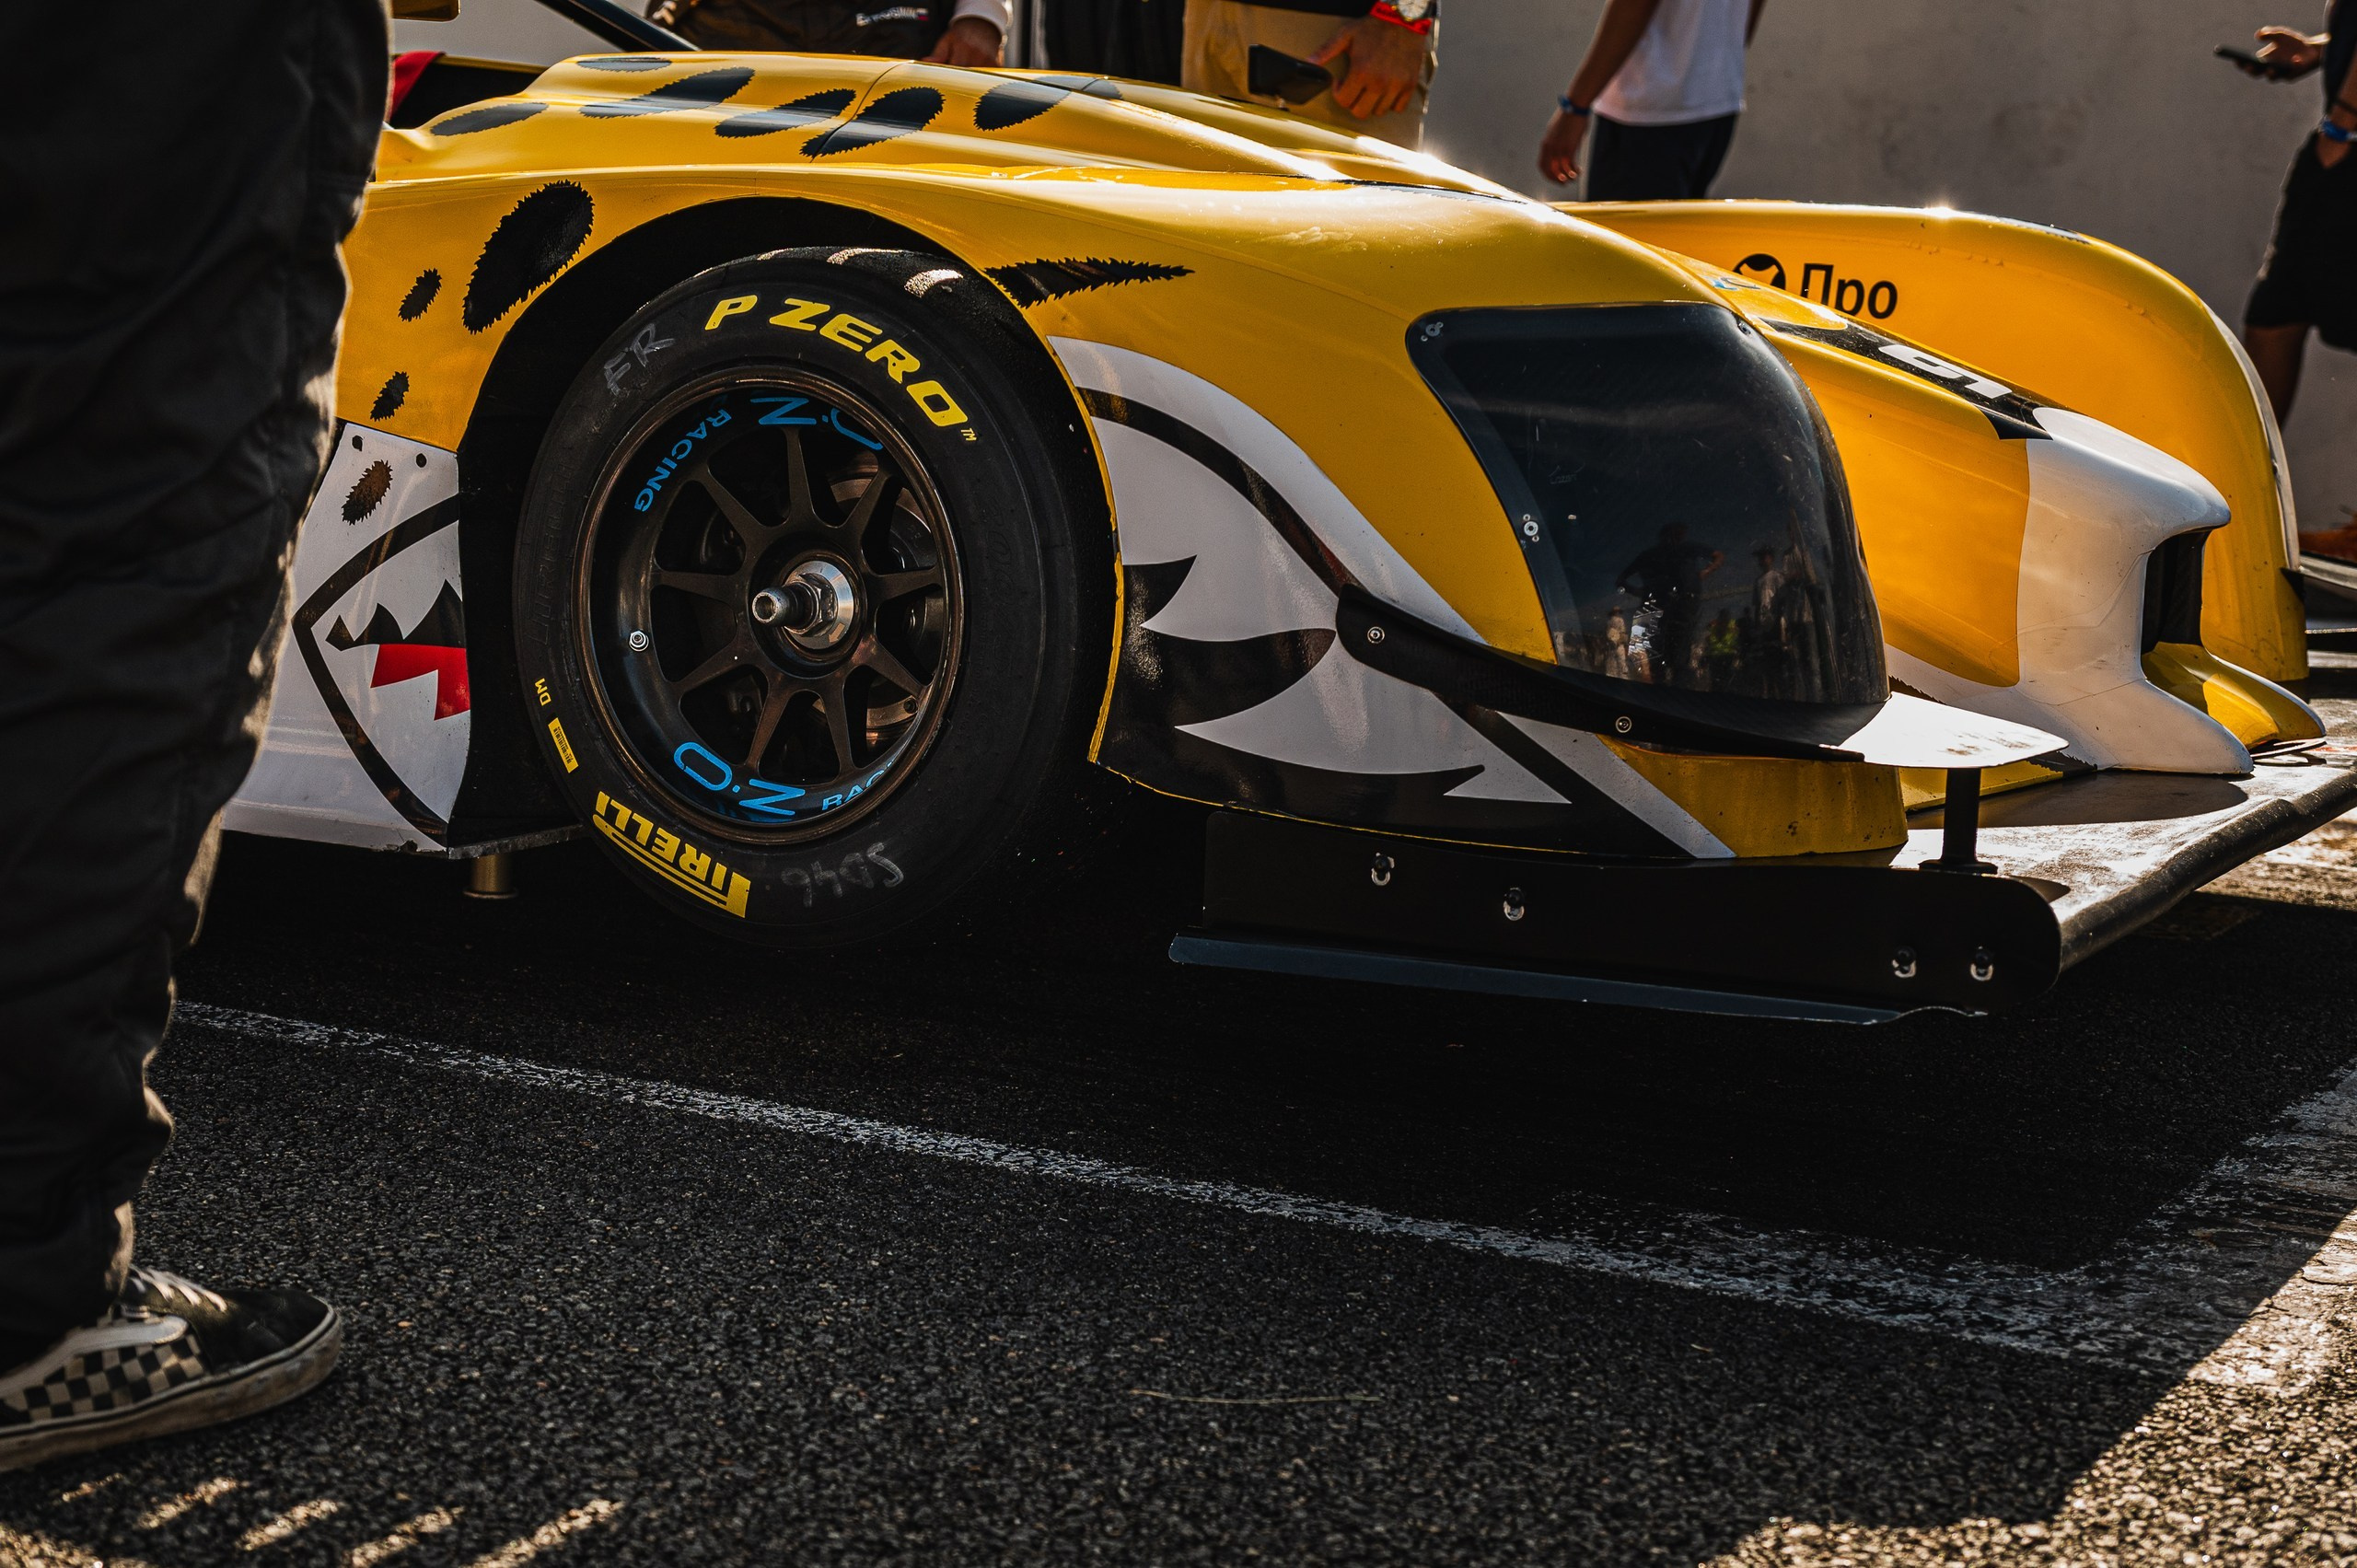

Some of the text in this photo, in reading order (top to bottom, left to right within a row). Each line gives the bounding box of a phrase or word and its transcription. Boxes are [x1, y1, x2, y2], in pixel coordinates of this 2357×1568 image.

[704, 294, 759, 331] P
[633, 409, 732, 513] RACING
[534, 678, 552, 706] DM
[592, 791, 751, 918] PIRELLI
